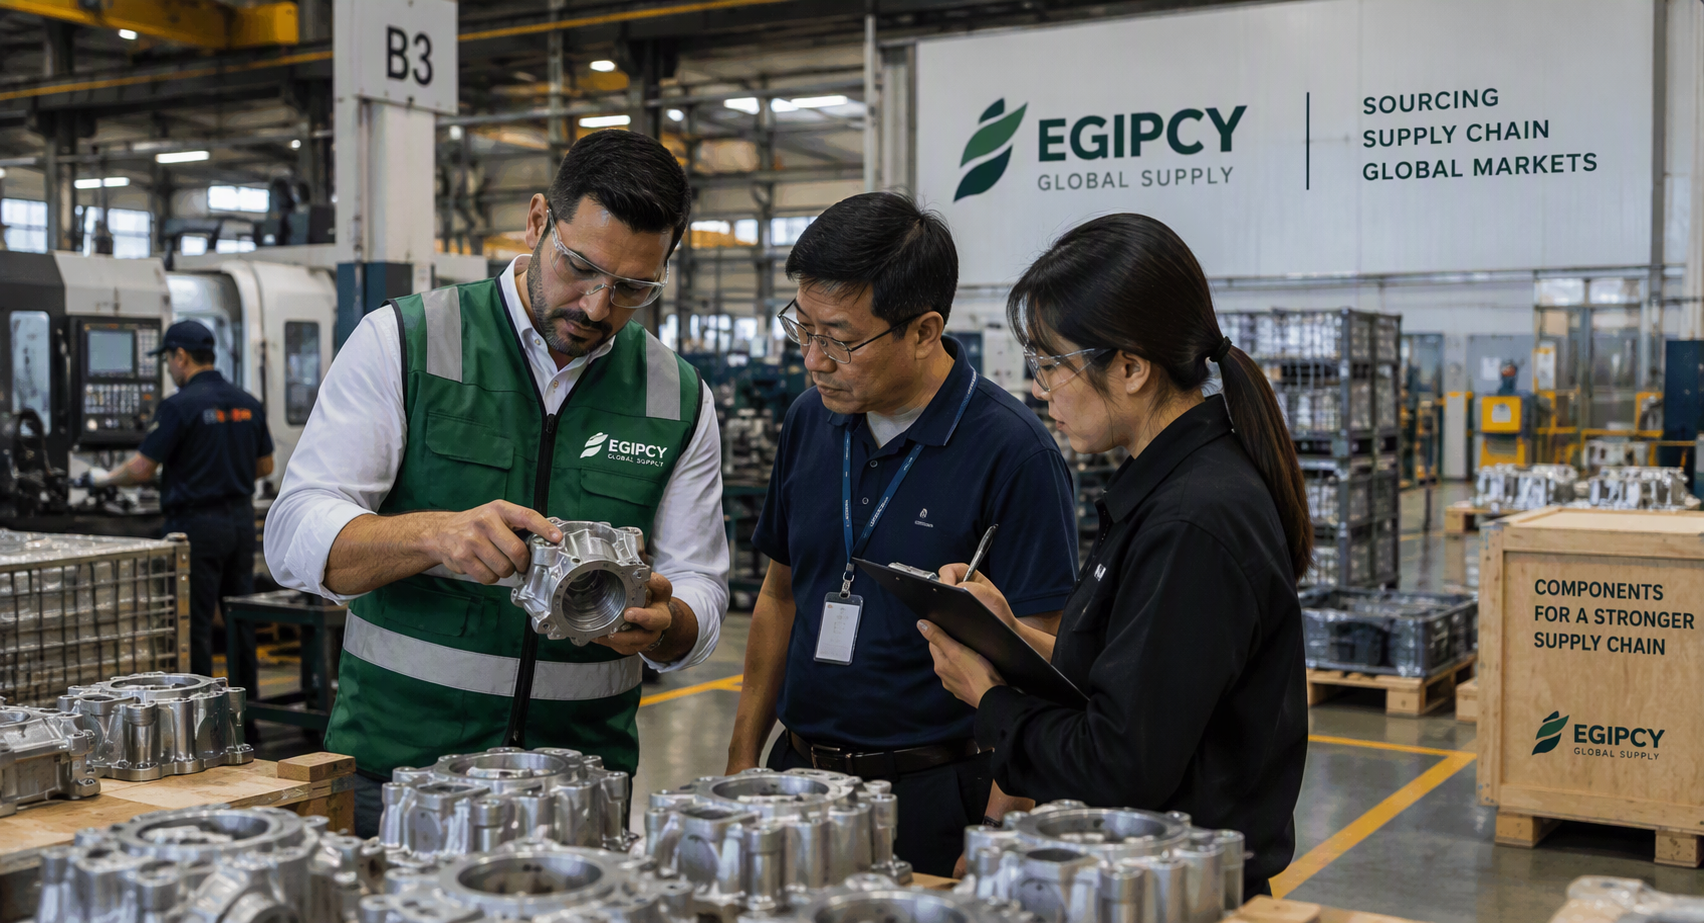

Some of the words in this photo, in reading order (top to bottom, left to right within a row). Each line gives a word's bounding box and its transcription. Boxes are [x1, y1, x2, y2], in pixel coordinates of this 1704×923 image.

[386, 25, 434, 87] B3
[1363, 87, 1499, 116] SOURCING
[1038, 104, 1248, 163] EGIPCY
[1362, 125, 1457, 149] SUPPLY
[1466, 119, 1549, 143] CHAIN
[1037, 170, 1130, 192] GLOBAL
[1140, 165, 1234, 189] SUPPLY
[1362, 158, 1464, 181] GLOBAL
[1473, 152, 1598, 177] MARKETS
[608, 439, 668, 459] EGIPCY
[1534, 578, 1664, 601] COMPONENTS
[1534, 604, 1571, 624] FOR
[1575, 607, 1589, 625] A
[1593, 607, 1695, 630] STRONGER
[1533, 631, 1602, 652] SUPPLY
[1606, 635, 1666, 656] CHAIN
[1573, 723, 1666, 749] EGIPCY
[1573, 747, 1616, 759] GLOBAL
[1619, 750, 1661, 761] SUPPLY
